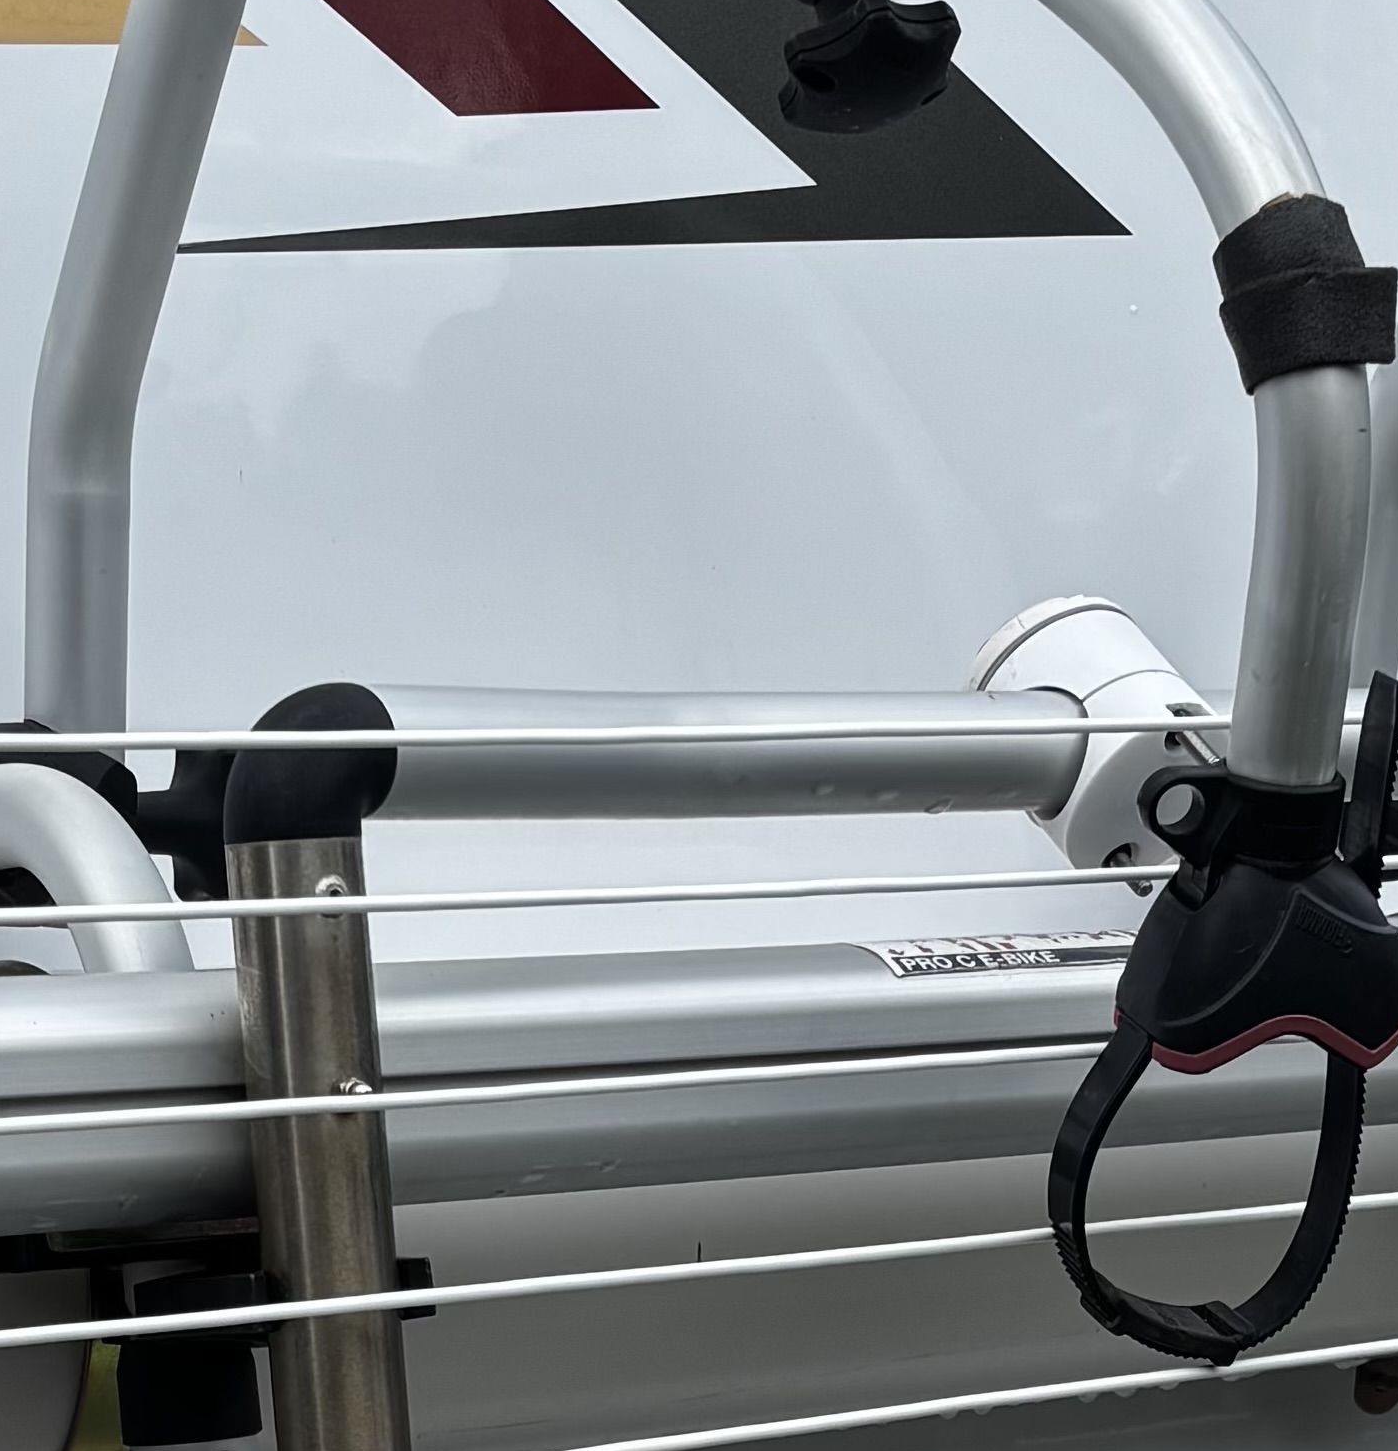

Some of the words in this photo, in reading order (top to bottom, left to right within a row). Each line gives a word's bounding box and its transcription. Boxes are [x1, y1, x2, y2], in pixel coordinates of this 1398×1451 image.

[899, 957, 953, 971] PRO
[956, 955, 976, 968] C
[977, 950, 1061, 967] E-BIKE
